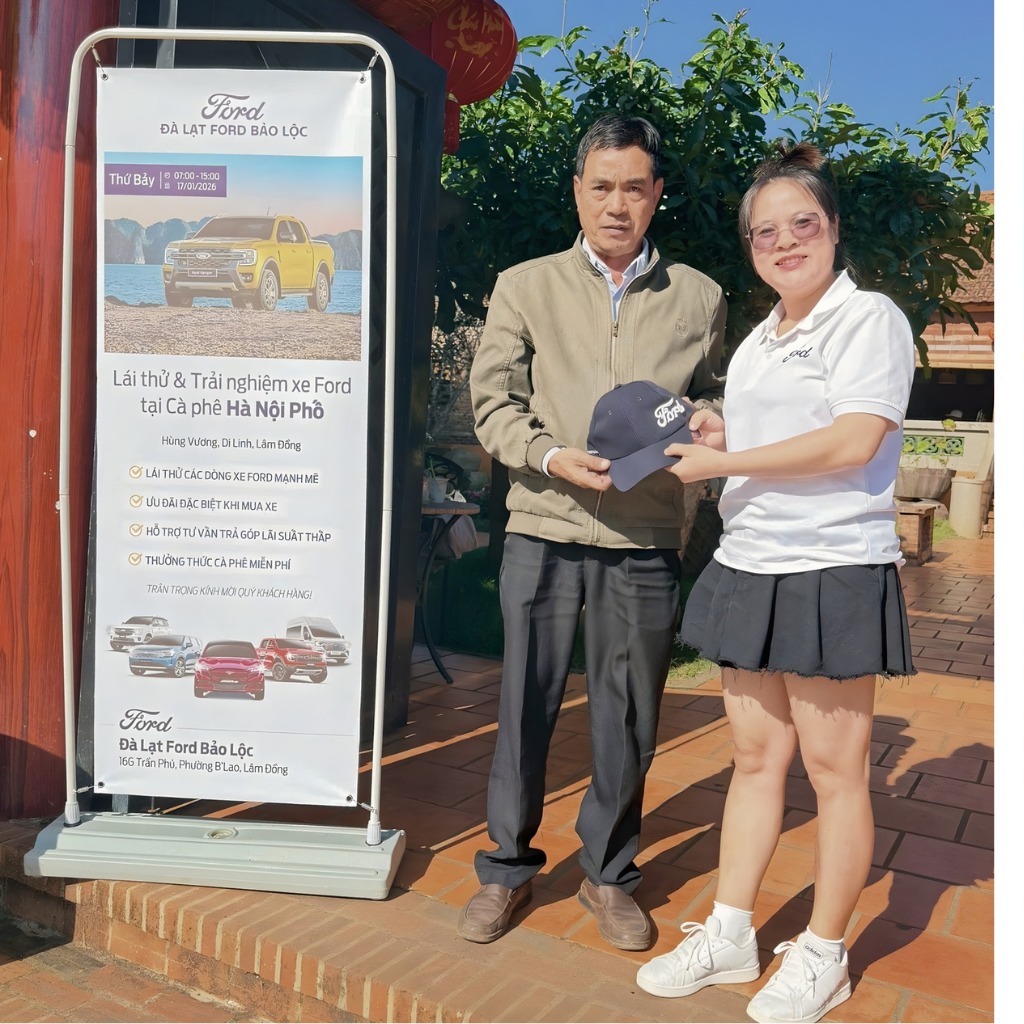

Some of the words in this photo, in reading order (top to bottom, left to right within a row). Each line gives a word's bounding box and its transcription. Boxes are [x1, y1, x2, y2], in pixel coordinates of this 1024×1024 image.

[201, 94, 266, 120] Ford
[160, 122, 178, 134] ĐÀ
[183, 124, 206, 137] LẠT
[211, 125, 246, 135] FORD
[251, 123, 278, 136] BẢO
[283, 124, 307, 139] LỘC
[109, 172, 132, 186] Thứ
[134, 174, 155, 188] Bảy
[174, 172, 194, 180] 07:00
[201, 173, 219, 181] 15:00
[177, 182, 216, 191] 17/01/2026
[114, 370, 136, 386] Lái
[141, 369, 169, 387] thử
[174, 372, 186, 388] &
[191, 371, 222, 389] Trải
[227, 374, 287, 394] nghiệm
[292, 380, 310, 392] xe
[315, 377, 351, 394] Ford
[141, 398, 161, 416] tại
[167, 398, 186, 414] Cà
[192, 399, 221, 417] phê
[227, 399, 251, 417] Hà
[256, 400, 285, 421] Nội
[290, 400, 324, 419] Phố
[654, 397, 686, 428] Ford
[162, 436, 185, 447] Hùng
[188, 437, 219, 448] Vương,
[222, 438, 230, 447] Di
[233, 439, 254, 448] Linh,
[257, 439, 275, 448] Lâm
[146, 467, 160, 478] LÁI
[162, 467, 183, 478] THỬ
[185, 468, 202, 479] CÁC
[205, 469, 231, 480] DÒNG
[234, 472, 245, 481] XE
[248, 473, 272, 482] FORD
[275, 474, 303, 484] MẠNH
[305, 473, 318, 483] MẼ
[147, 496, 160, 507] ƯU
[162, 497, 177, 507] ĐÃI
[180, 498, 198, 510] ĐẶC
[201, 498, 222, 511] BIỆT
[224, 501, 239, 510] KHI
[242, 502, 263, 510] MUA
[265, 502, 277, 511] XE
[147, 524, 160, 536] HỖ
[162, 527, 181, 538] TRỢ
[183, 527, 196, 537] TƯ
[220, 527, 238, 539] TRẢ
[241, 529, 260, 539] GÓP
[262, 530, 276, 540] LÃI
[145, 554, 185, 566] THƯỞNG
[187, 556, 212, 567] THỨC
[215, 557, 226, 567] CÀ
[229, 557, 247, 568] PHÊ
[250, 557, 272, 569] MIỄN
[275, 559, 291, 569] PHÍ
[120, 708, 173, 732] Ford
[119, 738, 137, 751] Đà
[141, 739, 163, 755] Lạt
[167, 741, 197, 754] Ford
[201, 740, 227, 755] Bảo
[230, 743, 253, 759] Lộc
[120, 757, 134, 766] 16G
[158, 759, 177, 768] Phú,
[179, 760, 213, 772] Phường
[244, 763, 263, 773] Lâm
